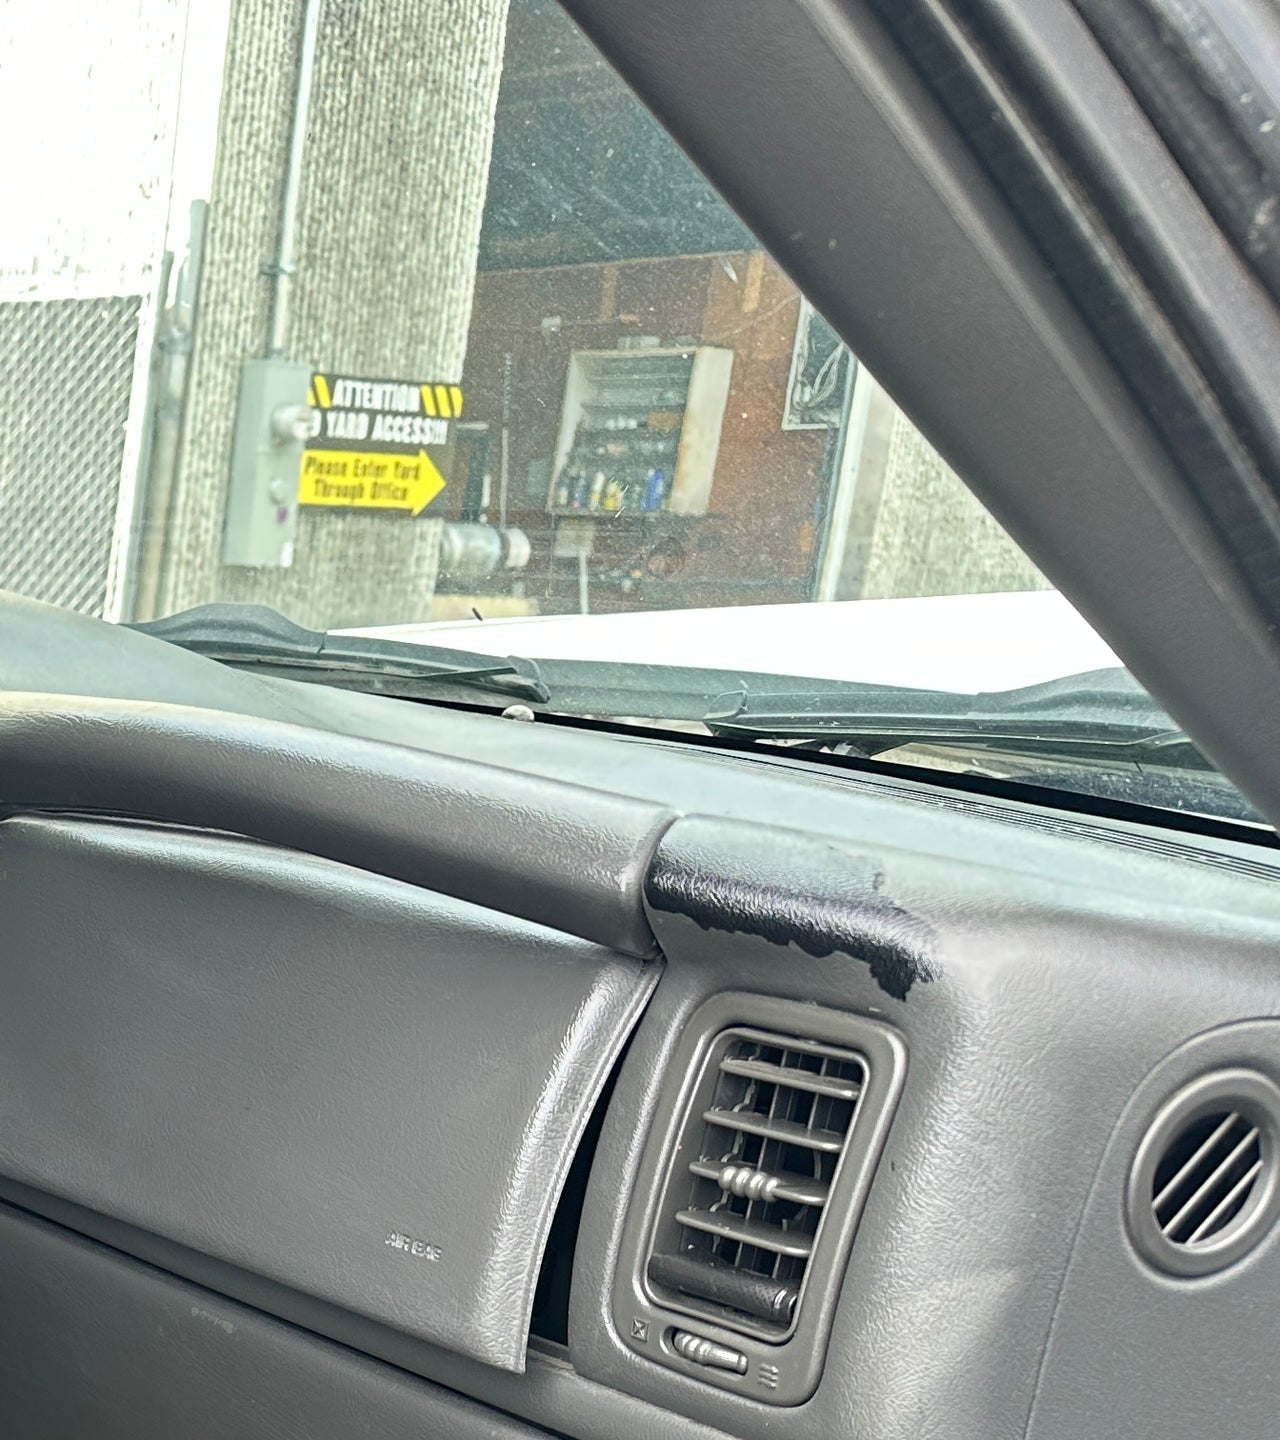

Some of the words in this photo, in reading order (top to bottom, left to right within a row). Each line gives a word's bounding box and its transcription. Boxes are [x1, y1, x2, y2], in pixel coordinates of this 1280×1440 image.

[332, 379, 421, 412] ATTENTION
[326, 411, 369, 440] YARD
[304, 456, 348, 477] Please
[393, 461, 421, 481] Yard
